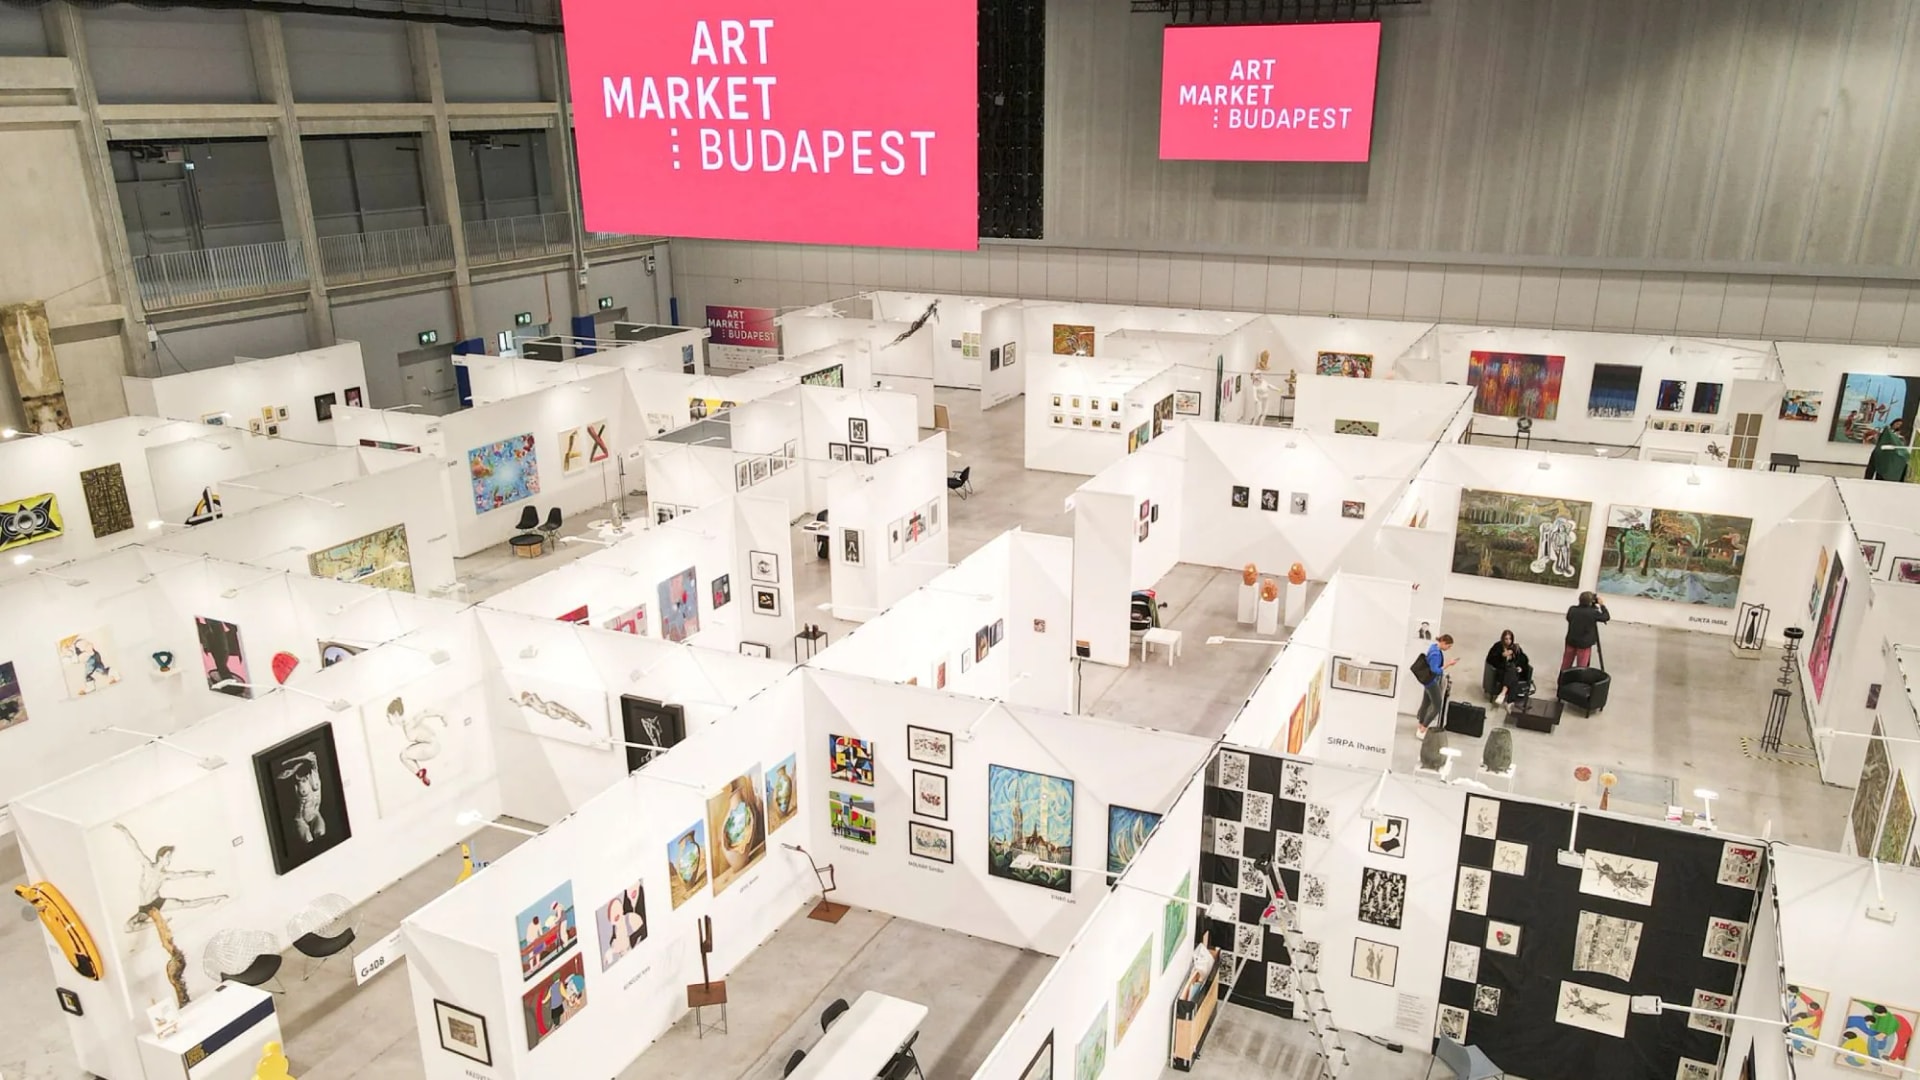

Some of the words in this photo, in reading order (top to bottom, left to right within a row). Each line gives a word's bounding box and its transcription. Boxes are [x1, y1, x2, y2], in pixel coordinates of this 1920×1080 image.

[691, 19, 774, 65] ART
[1230, 59, 1276, 80] ART
[602, 76, 777, 120] MARKET
[1179, 85, 1274, 105] MARKET
[1228, 107, 1352, 129] BUDAPEST
[700, 128, 936, 176] BUDAPEST
[708, 319, 745, 329] MARKET
[727, 310, 744, 319] ART
[728, 330, 775, 342] BUDAPEST
[1327, 736, 1355, 748] SIRPA
